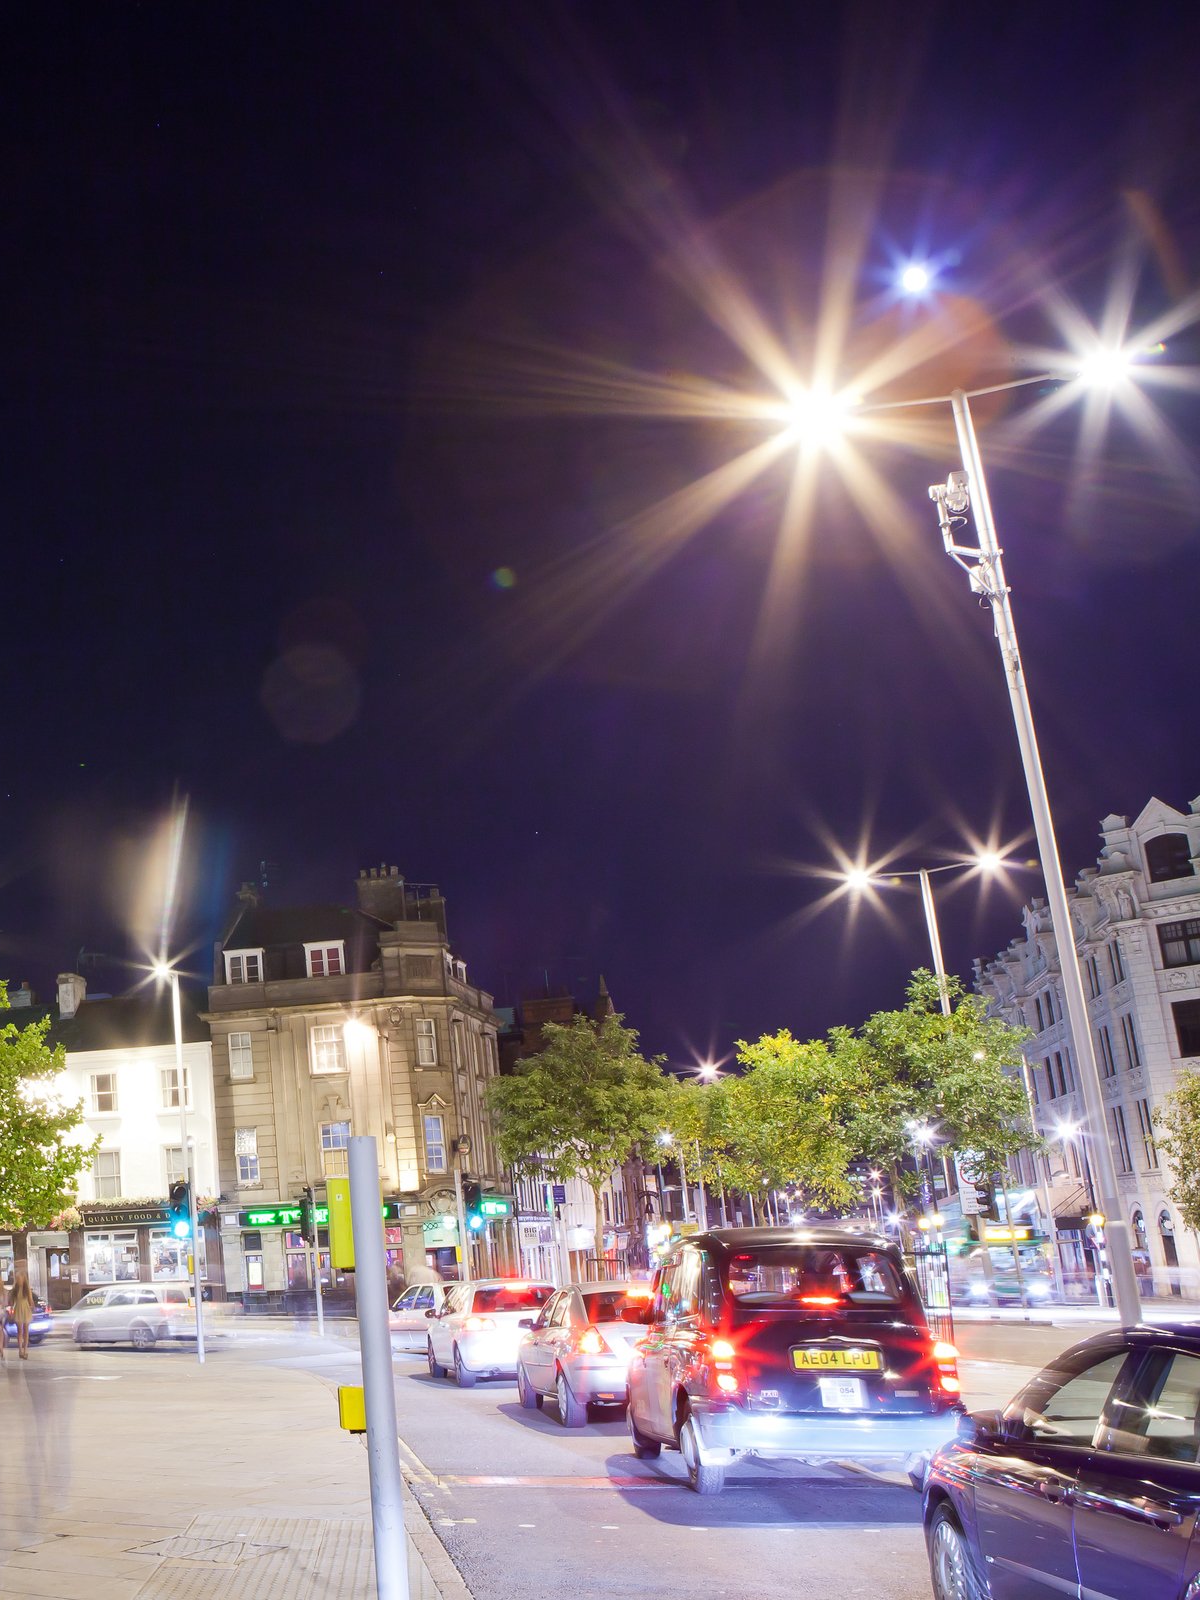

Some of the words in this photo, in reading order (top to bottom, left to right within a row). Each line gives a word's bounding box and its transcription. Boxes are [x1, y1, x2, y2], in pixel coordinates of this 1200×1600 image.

[88, 1215, 125, 1223] QUALITY
[128, 1213, 152, 1221] FOOD
[801, 1352, 839, 1365] AE04
[842, 1352, 871, 1365] LPU
